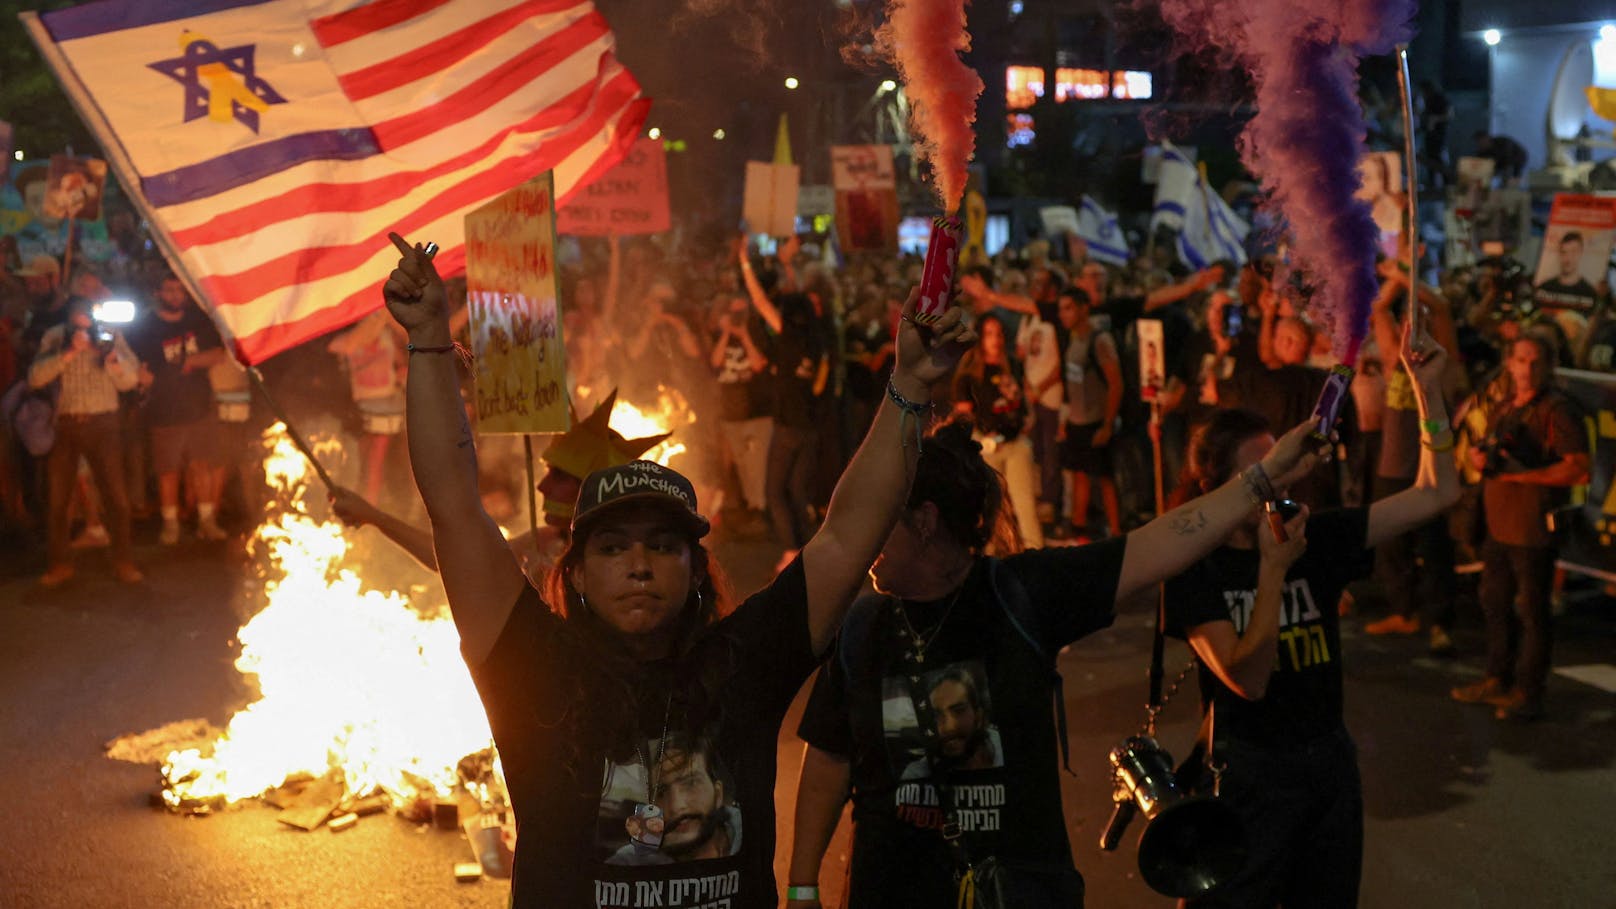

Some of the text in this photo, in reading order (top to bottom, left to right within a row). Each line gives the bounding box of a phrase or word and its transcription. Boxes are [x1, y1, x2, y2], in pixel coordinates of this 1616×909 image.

[594, 870, 740, 909] מחזירים את מתן
